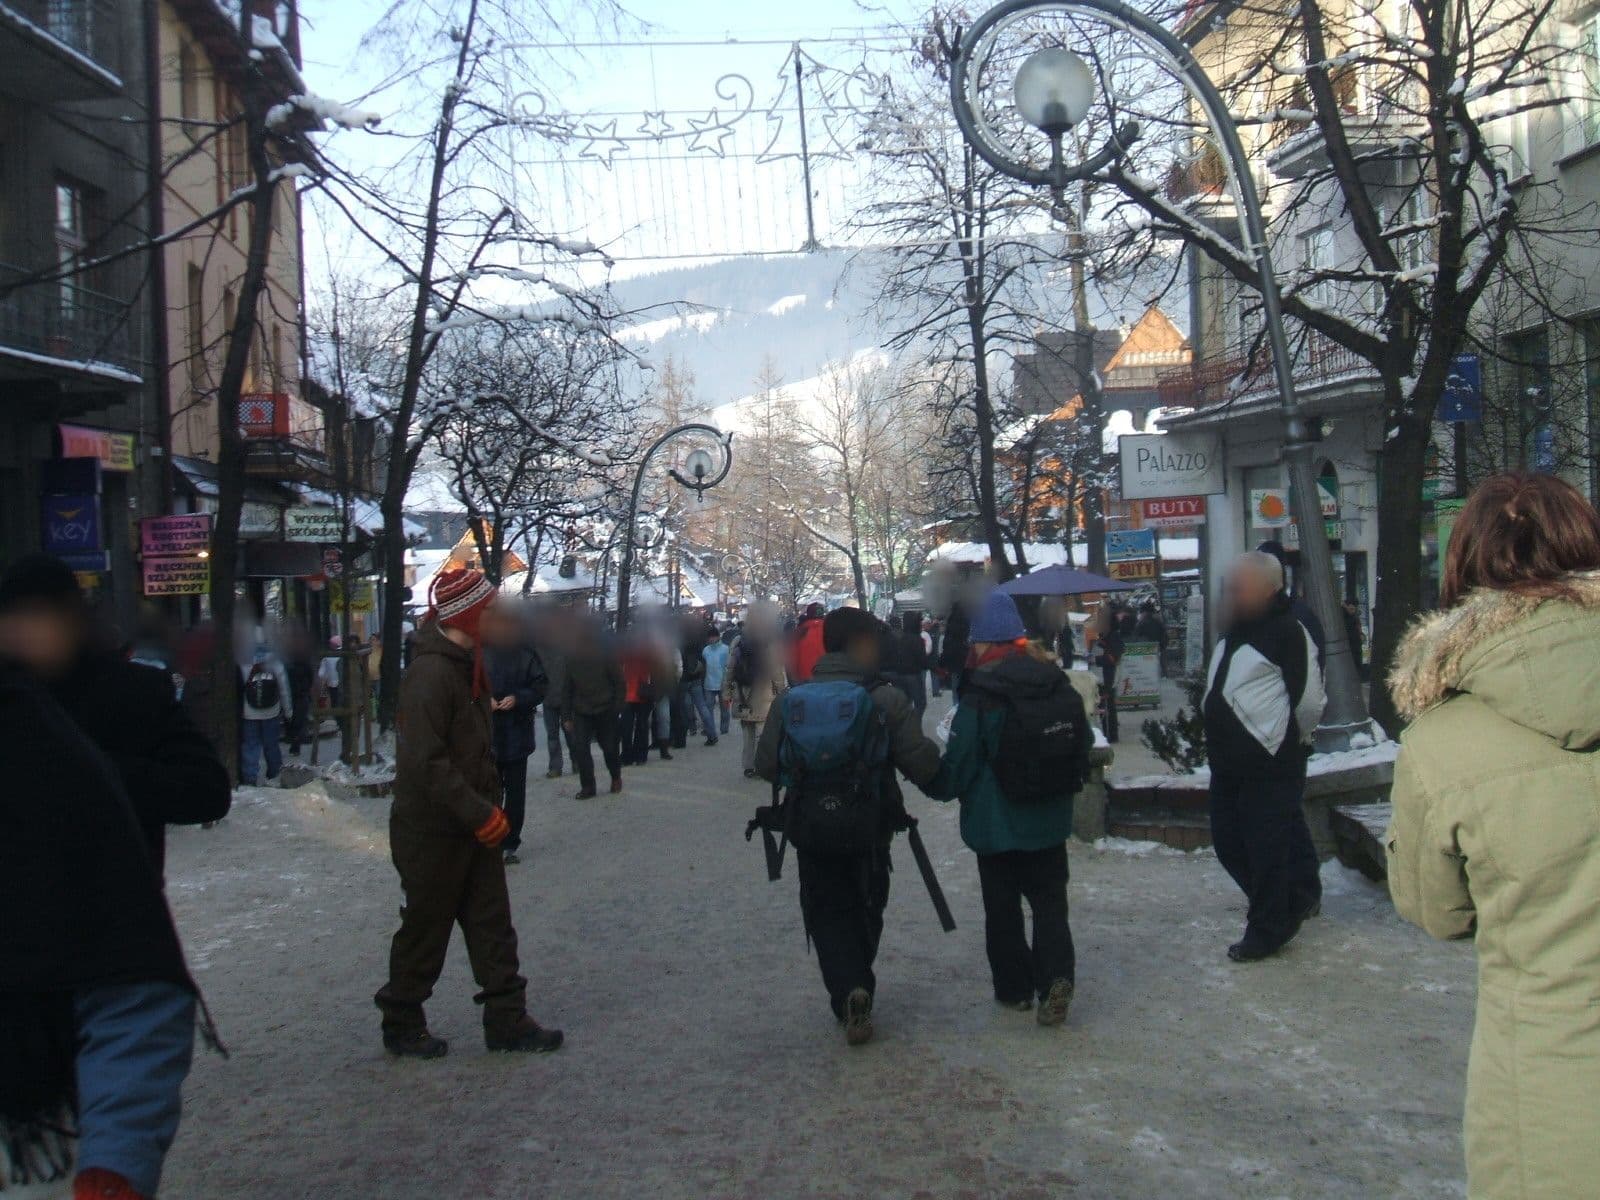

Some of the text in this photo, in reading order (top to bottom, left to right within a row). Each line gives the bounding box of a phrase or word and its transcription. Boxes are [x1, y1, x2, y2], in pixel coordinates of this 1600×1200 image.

[1149, 500, 1199, 515] BUTY
[49, 519, 92, 543] key
[1119, 562, 1152, 577] BUTY
[148, 583, 205, 593] RAJSTOPY
